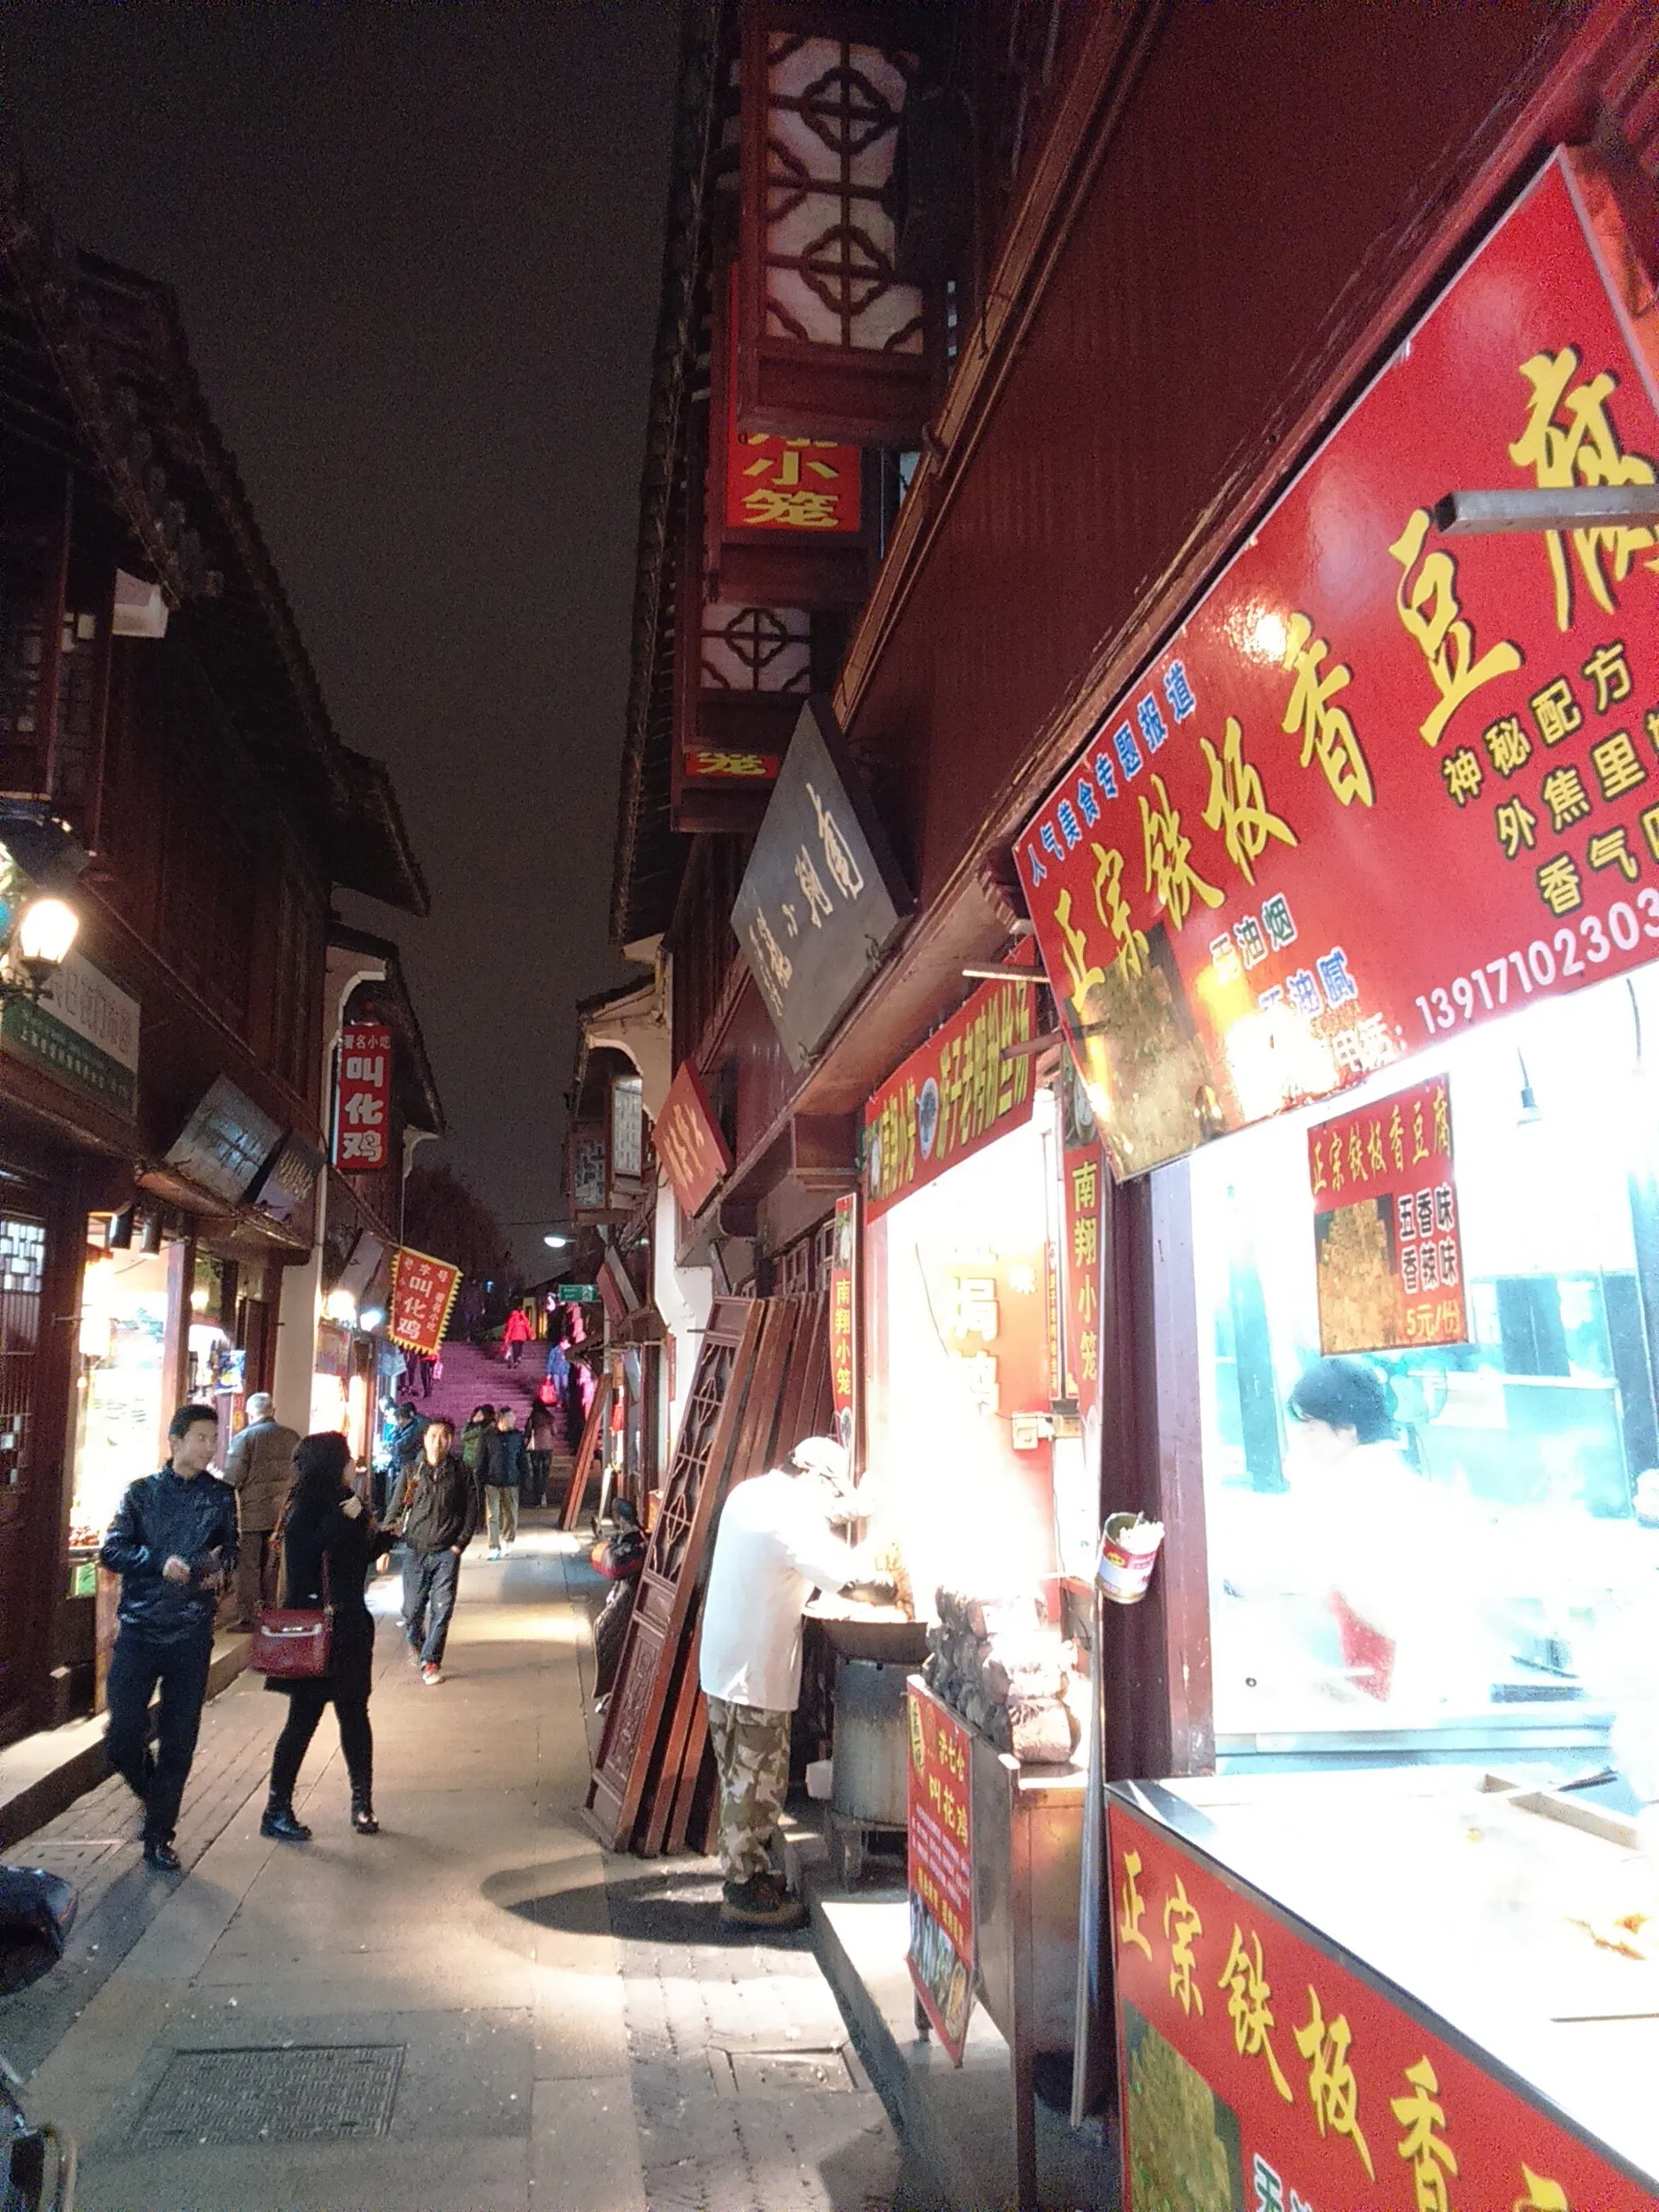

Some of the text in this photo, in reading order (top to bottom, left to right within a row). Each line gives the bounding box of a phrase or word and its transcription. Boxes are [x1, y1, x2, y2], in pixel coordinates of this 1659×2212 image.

[741, 434, 840, 527] 小笼
[1026, 659, 1196, 888] 人气美食专题报道
[1442, 641, 1634, 806] 神秘配方
[1495, 710, 1659, 859] 外焦里
[1415, 887, 1659, 1034] 13917102303
[342, 1033, 391, 1051] 著名小吃
[342, 1056, 385, 1164] 叫化鸡
[1313, 1086, 1451, 1194] 正宗铁板香豆腐
[1398, 1181, 1455, 1242] 五香味
[396, 1275, 434, 1340] 叫化鸡
[1071, 1159, 1098, 1382] 南翔小笼
[1406, 1298, 1460, 1337] 5元/份
[834, 1279, 852, 1395] 南翔小笼
[1119, 1848, 1571, 2212] 正宗铁板香
